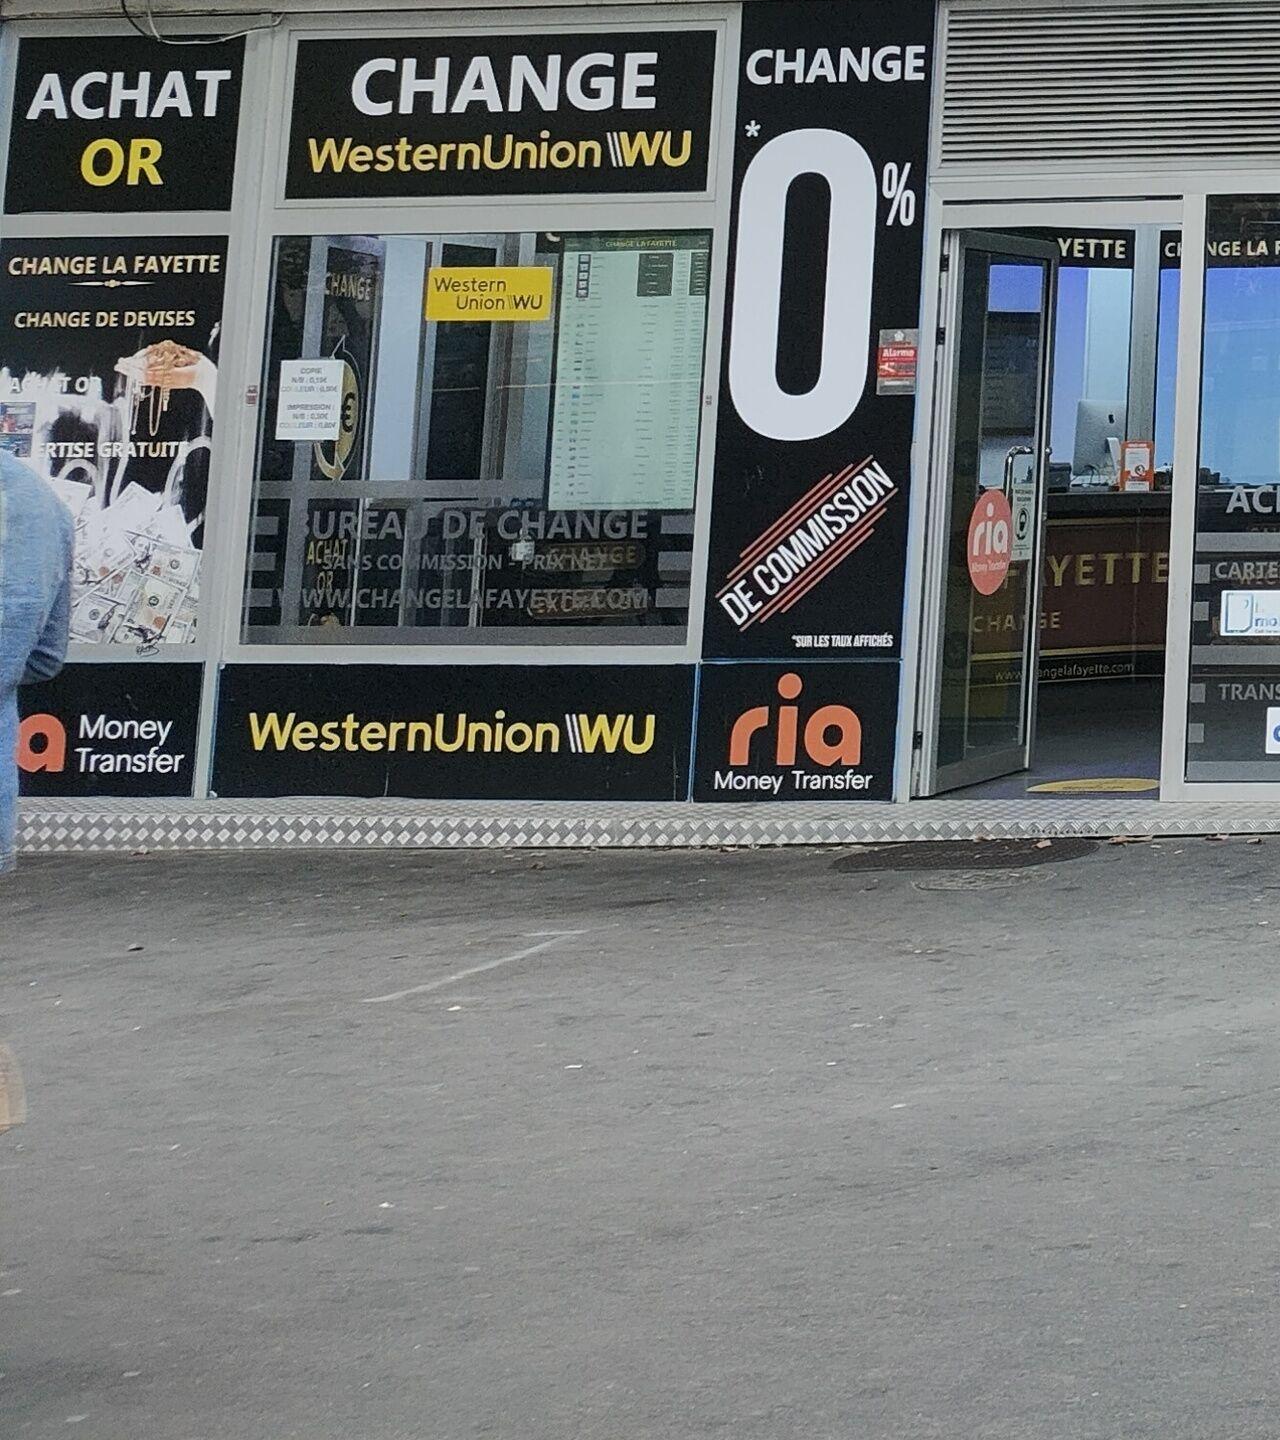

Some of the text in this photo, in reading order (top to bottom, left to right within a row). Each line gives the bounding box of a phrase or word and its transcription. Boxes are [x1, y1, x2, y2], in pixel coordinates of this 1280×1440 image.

[745, 45, 926, 85] CHANGE
[26, 69, 231, 120] ACHAT
[351, 52, 658, 116] CHANGE
[80, 137, 164, 186] OR
[308, 129, 601, 174] WesternUnion
[1247, 240, 1269, 256] LA
[8, 255, 220, 276] CHANGE LA FAYETTE
[434, 277, 507, 292] Western
[456, 294, 505, 310] Union
[14, 310, 196, 328] CHANGE DE DEVISES
[443, 510, 486, 540] DE
[497, 510, 649, 540] CHANGE
[973, 502, 1009, 556] ria
[719, 460, 895, 626] DE COMMISSION
[1215, 561, 1279, 579] CARTE
[813, 635, 829, 647] LES
[831, 634, 852, 647] TAUX
[79, 714, 173, 746] Money
[248, 710, 560, 755] WesternUnion
[728, 672, 863, 767] ria
[74, 746, 185, 773] Transfer
[714, 769, 874, 795] Money Transfer
